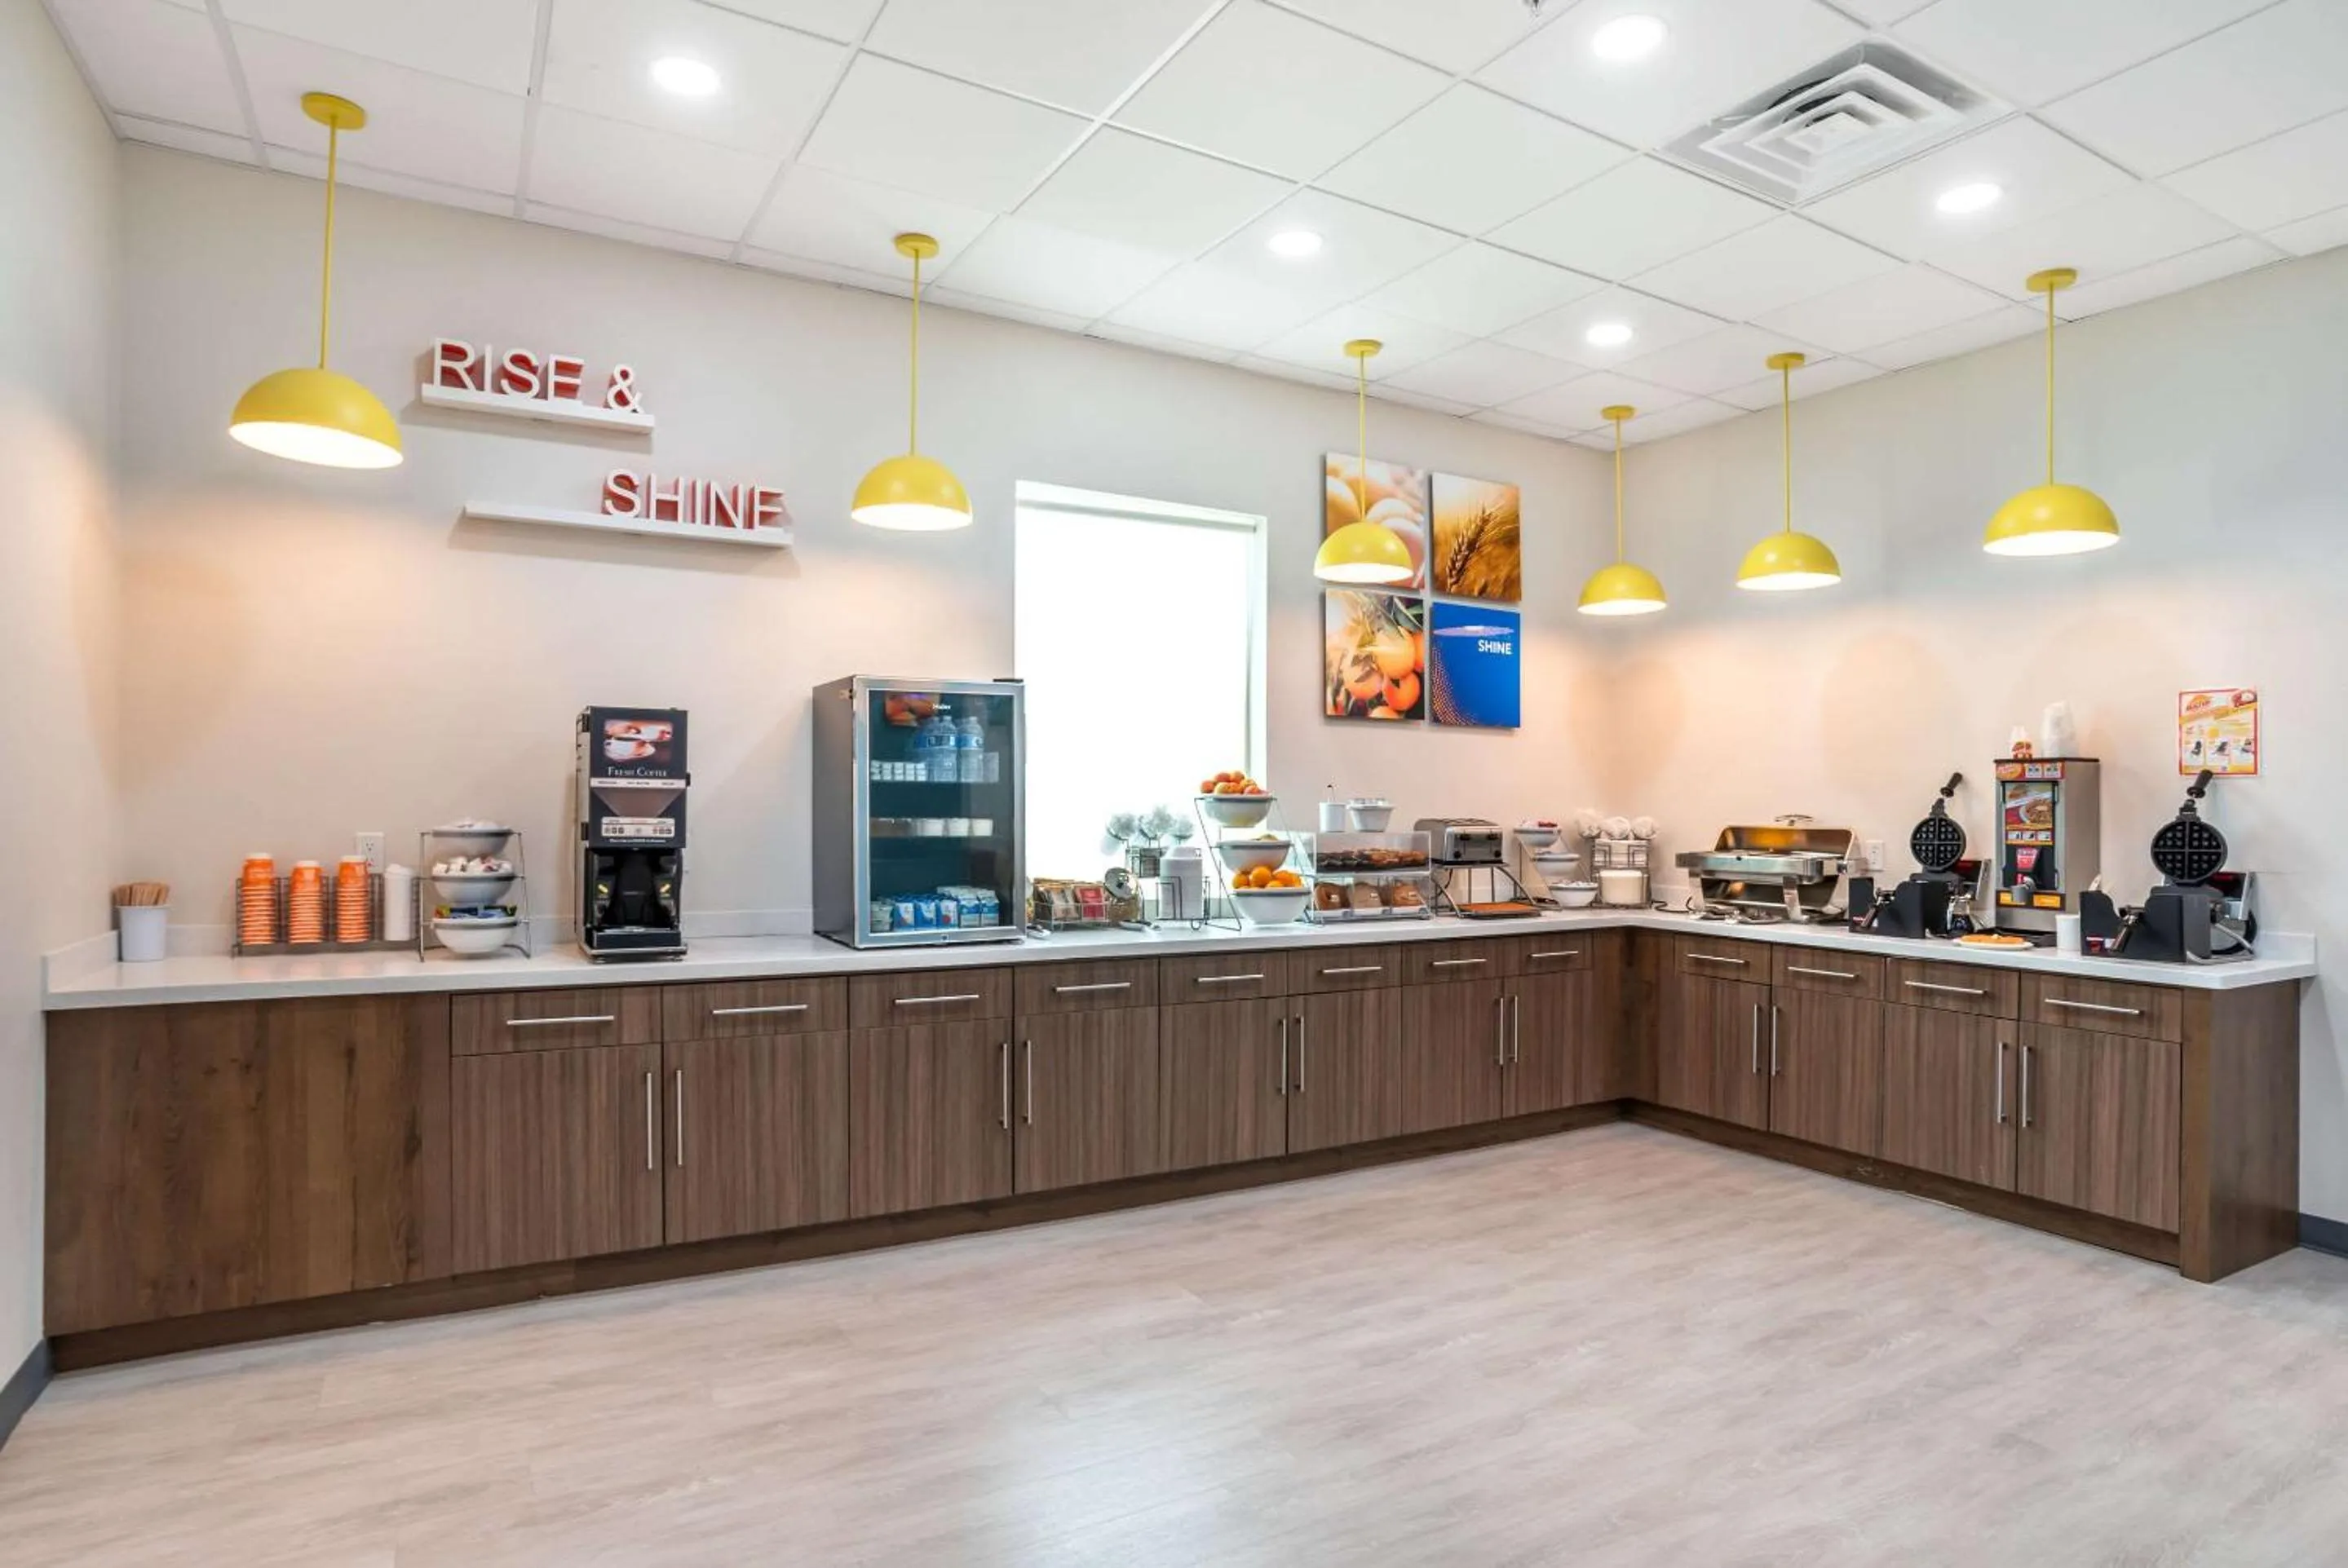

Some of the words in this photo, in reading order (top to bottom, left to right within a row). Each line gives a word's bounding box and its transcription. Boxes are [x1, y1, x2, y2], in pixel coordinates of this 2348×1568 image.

[431, 337, 586, 405] RISE
[604, 363, 644, 414] &
[604, 468, 785, 532] SHINE
[1477, 638, 1513, 655] SHINE
